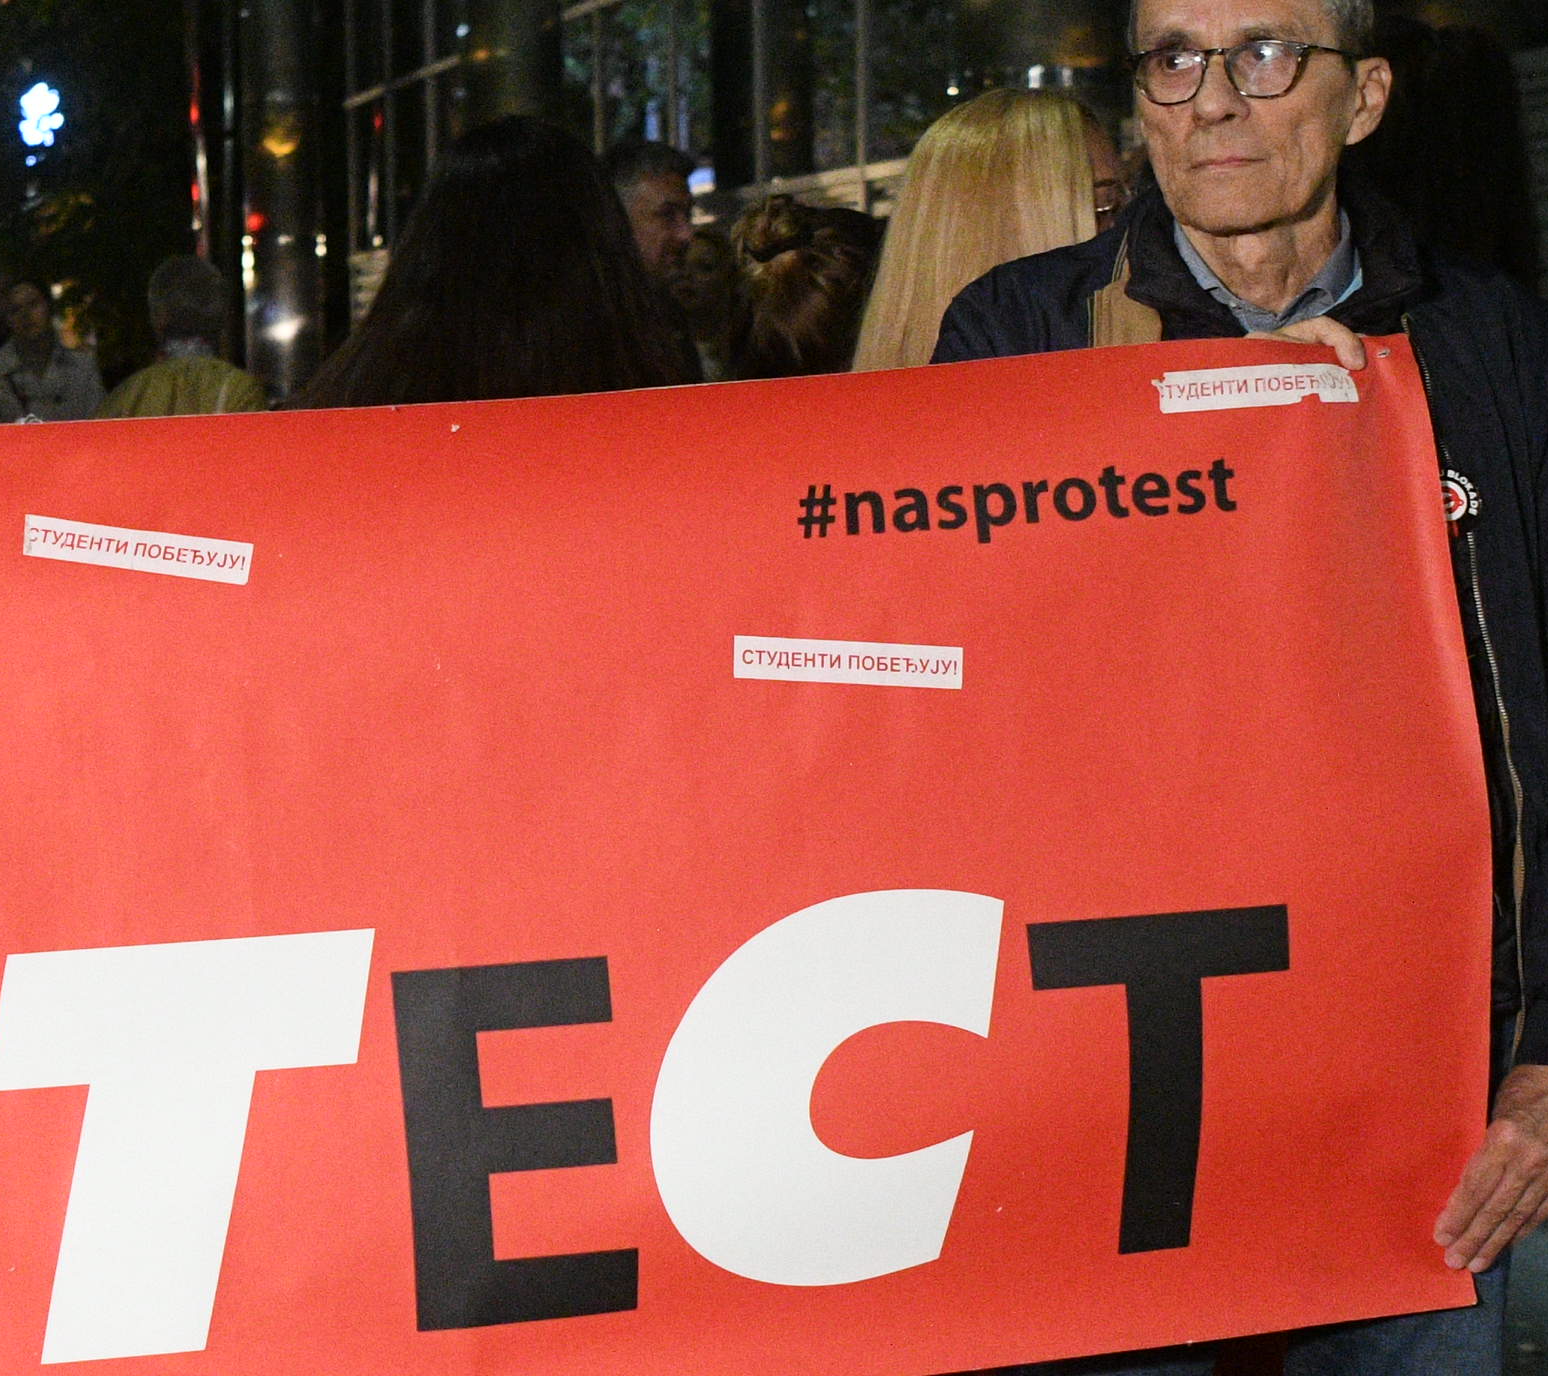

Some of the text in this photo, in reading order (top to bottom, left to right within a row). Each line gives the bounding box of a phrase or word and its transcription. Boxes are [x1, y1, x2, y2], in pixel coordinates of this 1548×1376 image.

[1160, 379, 1248, 401] ТУДЕНТИ
[796, 457, 1237, 543] #nasprotest
[28, 527, 246, 571] СТУДЕНТИ ПОБЕЂУЈУ!
[741, 649, 958, 675] СТУДЕНТИ ПОБЕЂУЈУ!
